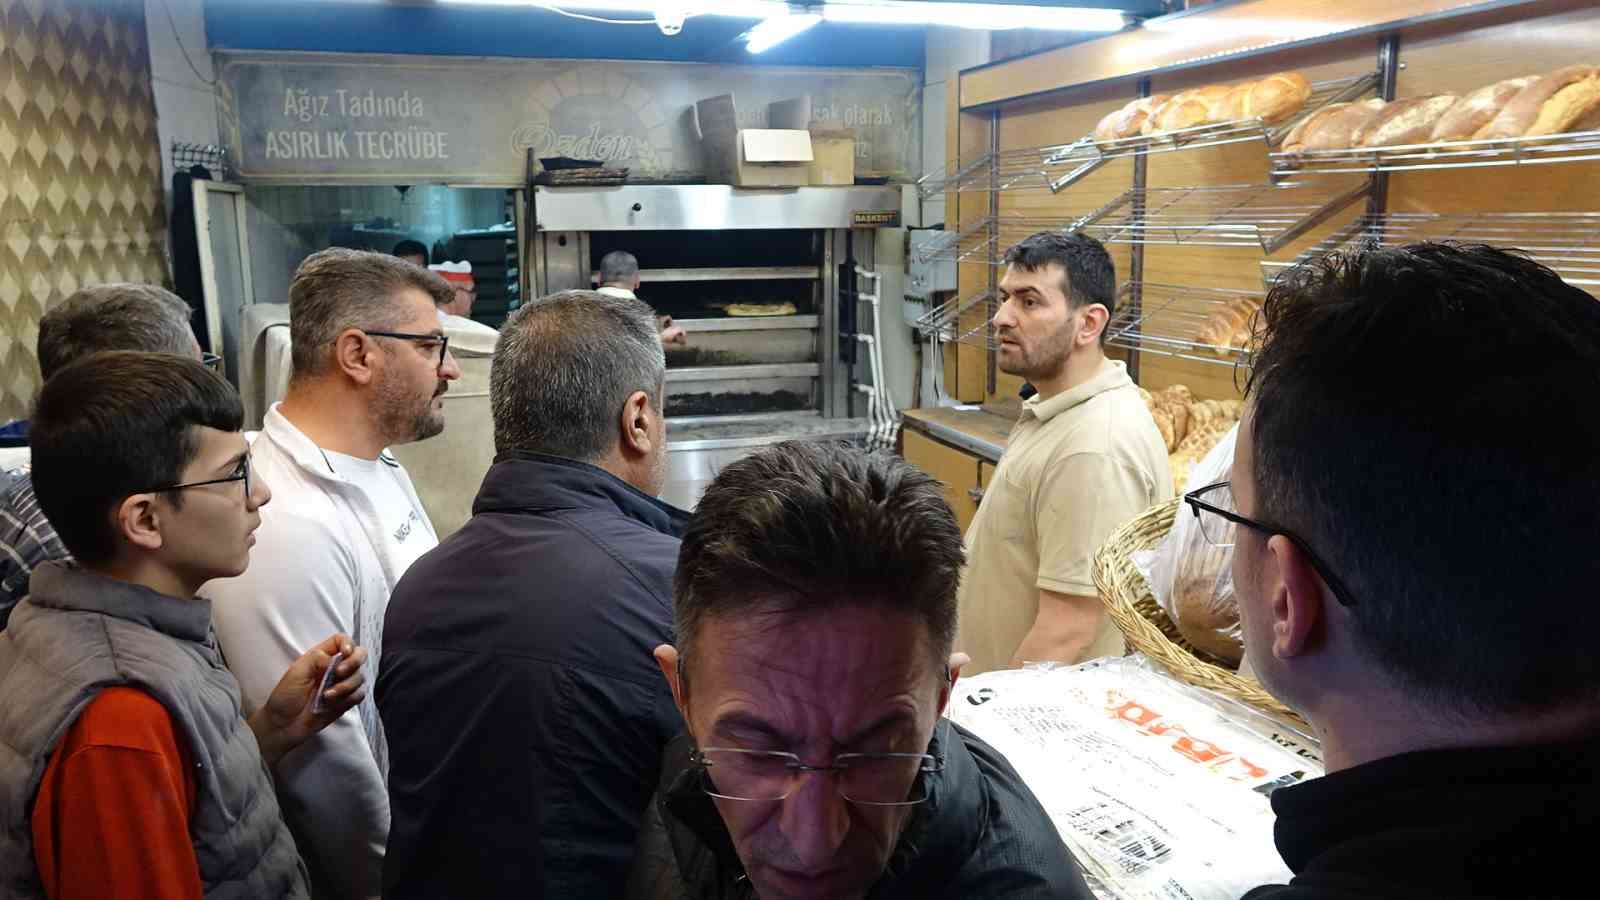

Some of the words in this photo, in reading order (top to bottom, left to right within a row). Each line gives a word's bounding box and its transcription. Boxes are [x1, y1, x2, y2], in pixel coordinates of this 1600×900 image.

[283, 87, 329, 122] Ağız
[336, 88, 424, 118] Tadında
[844, 103, 893, 126] olarak
[264, 130, 350, 160] ASIRLIK
[354, 125, 450, 159] TECRÜBE
